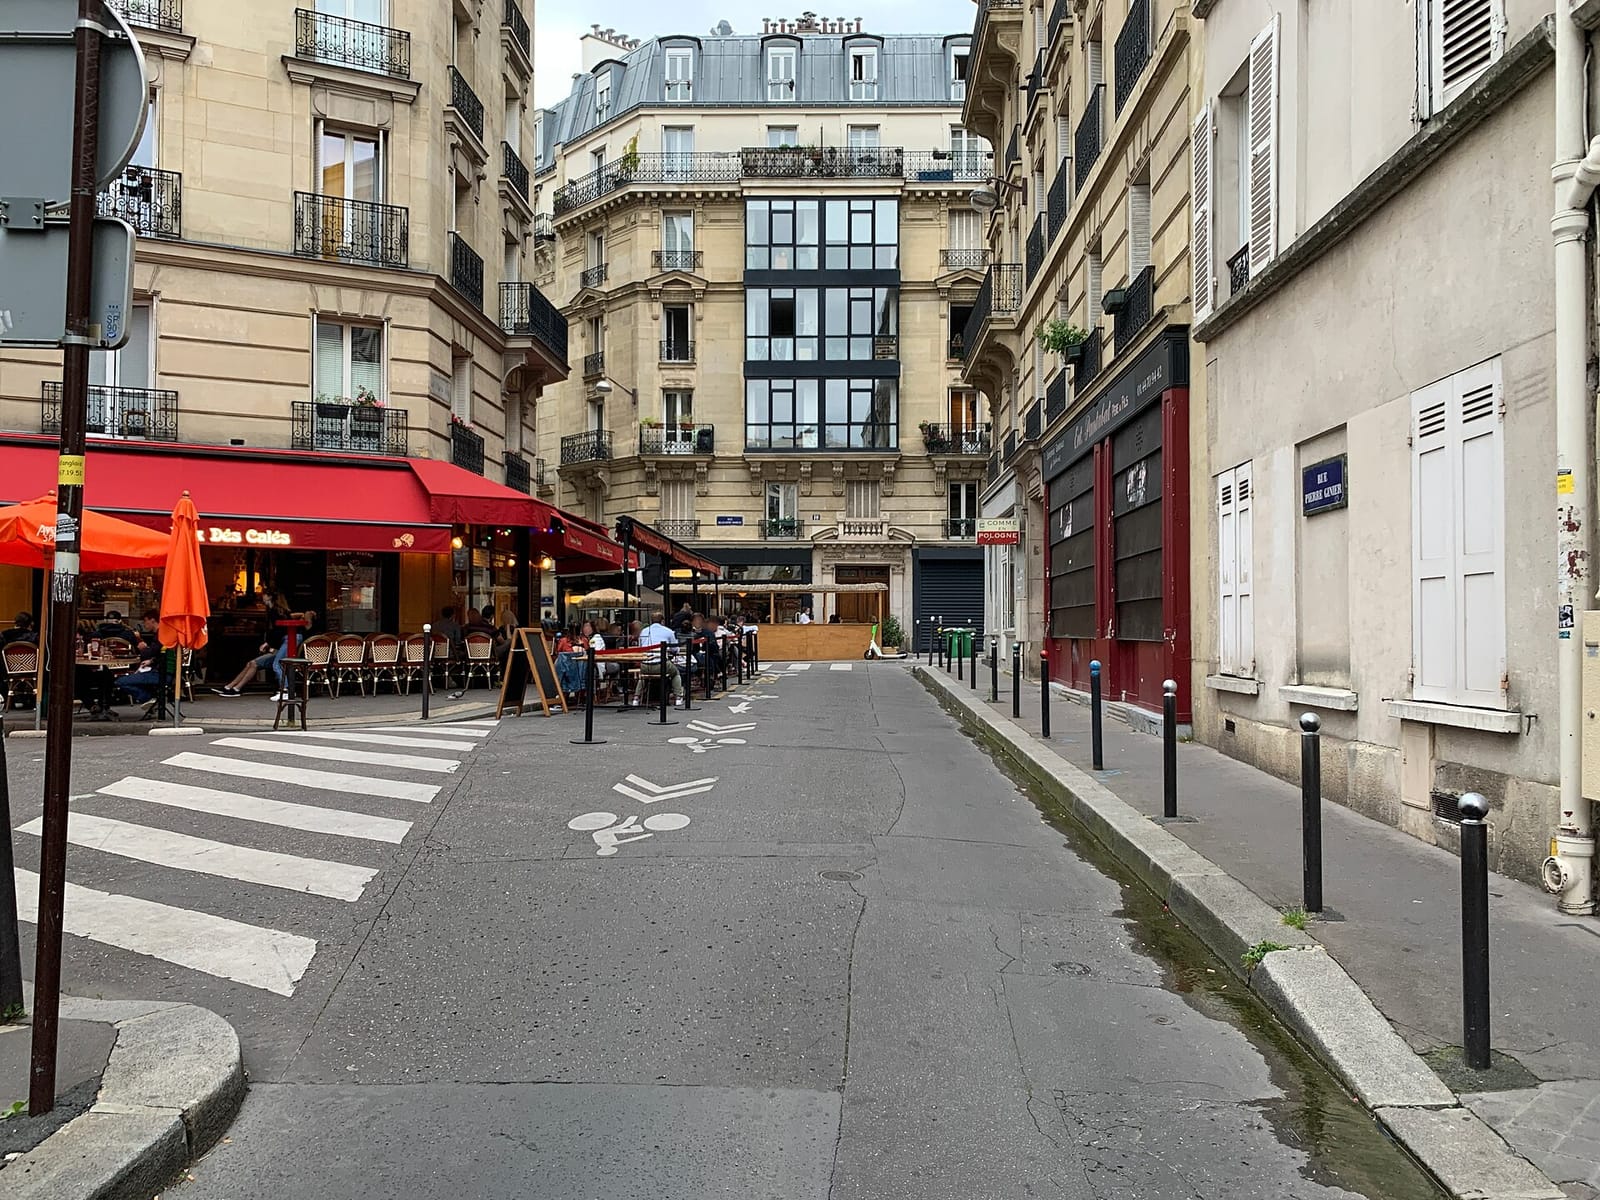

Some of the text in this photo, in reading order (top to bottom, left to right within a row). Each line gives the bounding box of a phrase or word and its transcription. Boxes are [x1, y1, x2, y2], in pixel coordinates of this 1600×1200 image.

[1317, 472, 1328, 485] RUE
[1305, 483, 1342, 504] PIERRE GINIER
[209, 527, 242, 543] Dés
[245, 528, 291, 545] Calés
